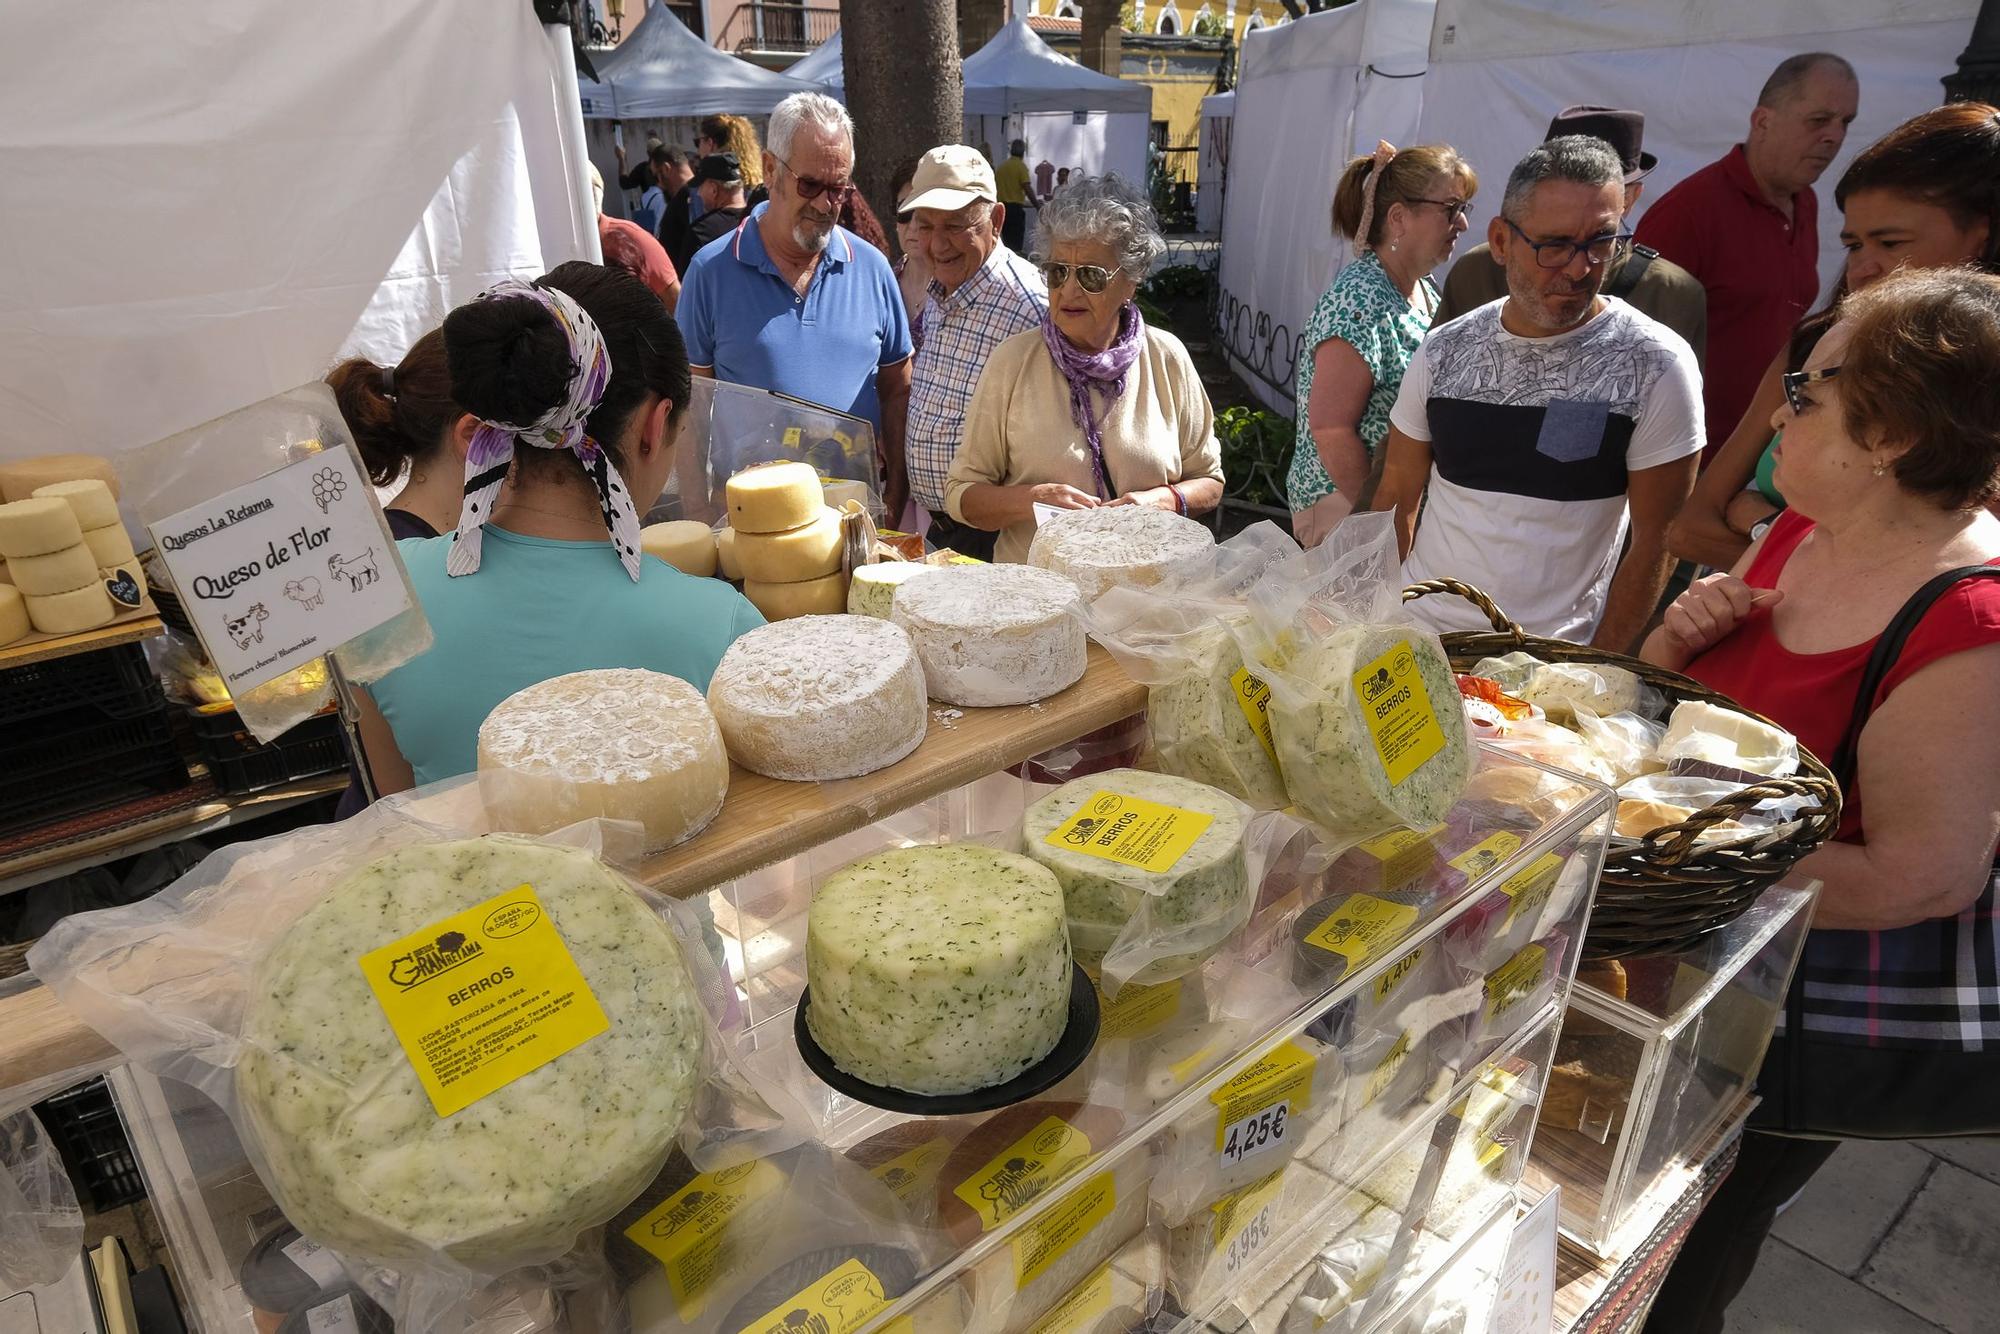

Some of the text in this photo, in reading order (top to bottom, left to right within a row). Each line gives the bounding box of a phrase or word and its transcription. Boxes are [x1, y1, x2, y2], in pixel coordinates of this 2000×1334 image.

[162, 498, 274, 550] Quesos La Retama
[193, 526, 331, 599] Queso de Flor
[228, 667, 254, 682] Flowers
[1376, 685, 1411, 720] BERROS
[1096, 812, 1138, 846] BERROS
[389, 950, 450, 986] GRAN
[446, 941, 483, 965] RETAMA
[447, 966, 514, 1006] BERROS
[417, 1028, 442, 1044] LECHE
[444, 1003, 495, 1030] PASTERIZADA
[527, 1003, 551, 1017] Teresa
[1224, 1105, 1287, 1161] 4,25€
[696, 1195, 733, 1224] MEZCLA
[696, 1193, 747, 1234] VINO TINTO
[1227, 1205, 1269, 1272] 3,95€
